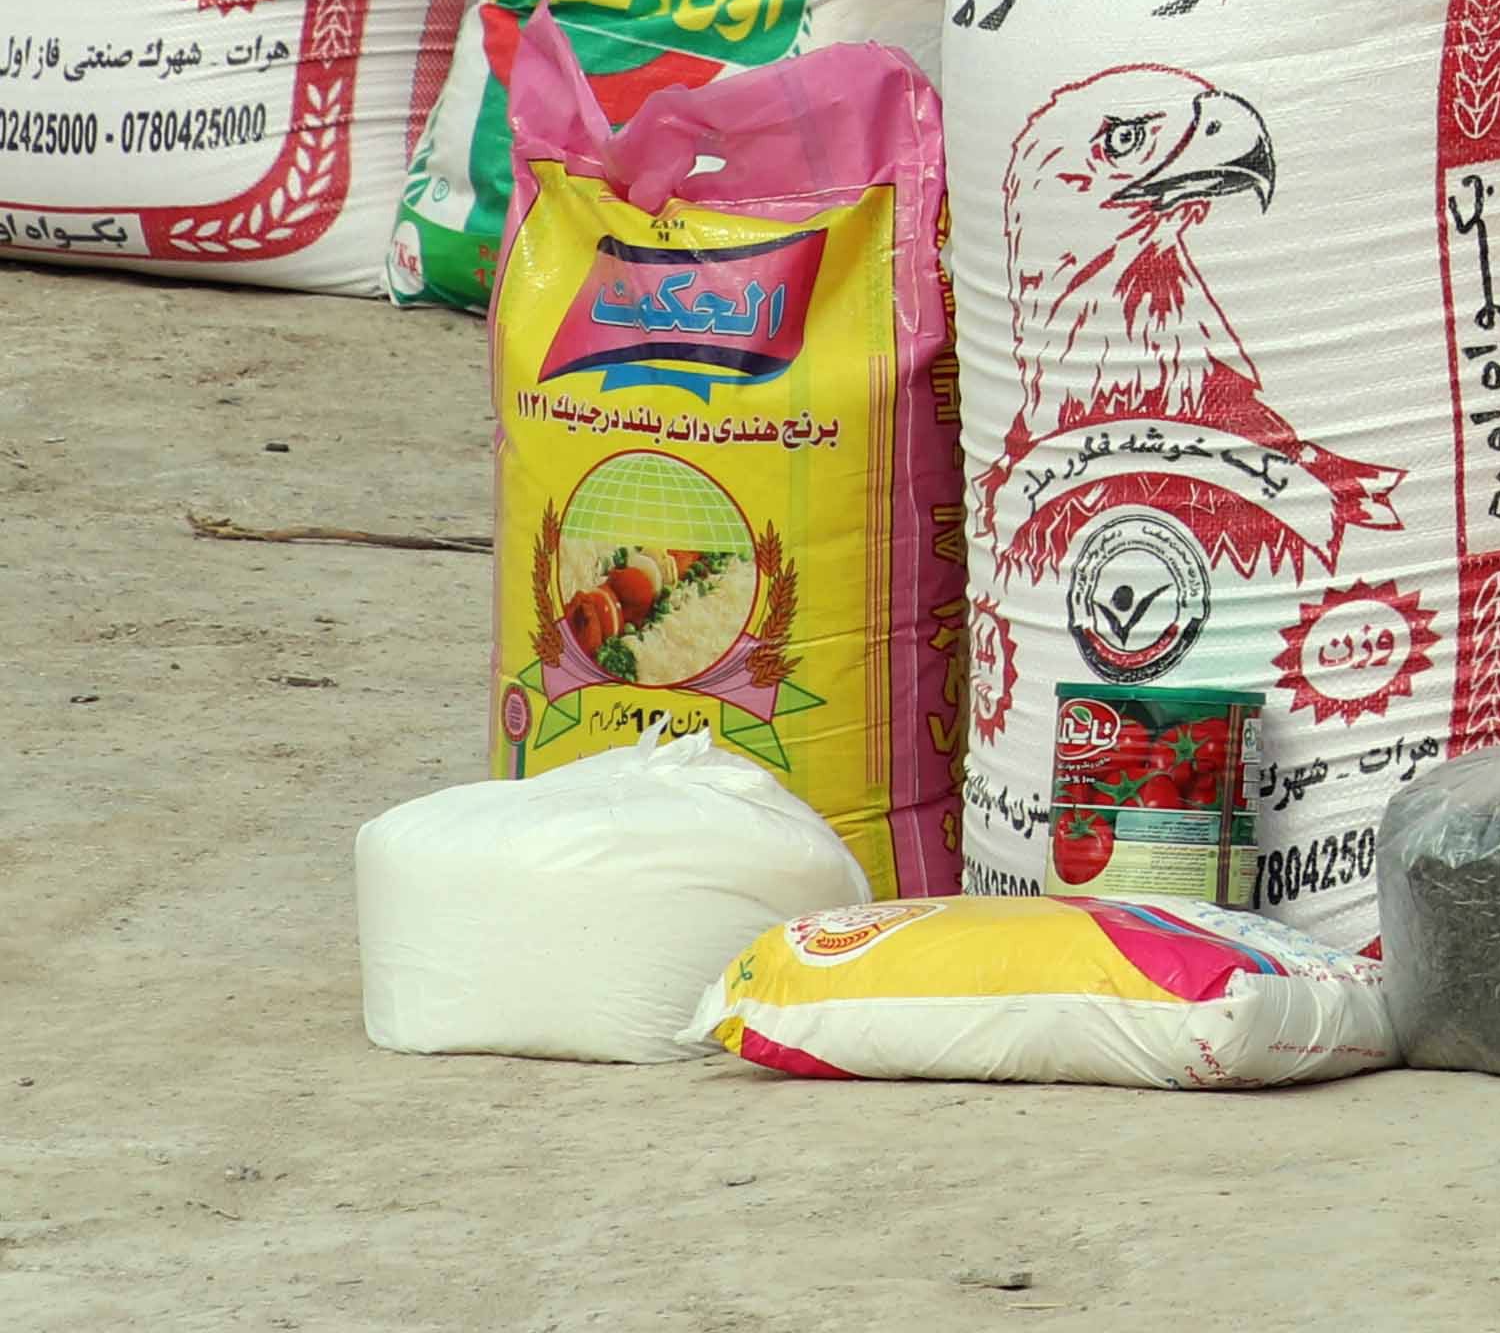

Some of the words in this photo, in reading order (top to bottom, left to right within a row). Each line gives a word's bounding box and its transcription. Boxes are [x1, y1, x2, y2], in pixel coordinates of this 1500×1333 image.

[32, 37, 62, 81] فاز
[65, 44, 132, 82] صنعتی
[226, 34, 292, 75] هرات
[121, 102, 268, 155] 0780425000
[26, 215, 128, 248] بکواه
[516, 390, 549, 423] ۱۱۲۱
[621, 402, 664, 445] بلند
[665, 412, 712, 444] دانه
[713, 417, 780, 446] هندی
[782, 406, 841, 450] برنج
[1120, 428, 1214, 461] خوشه
[1062, 432, 1114, 481] فلور
[1221, 447, 1296, 499] یک
[1316, 622, 1396, 670] وزن
[668, 710, 712, 738] وزن
[1358, 735, 1440, 784] هرات
